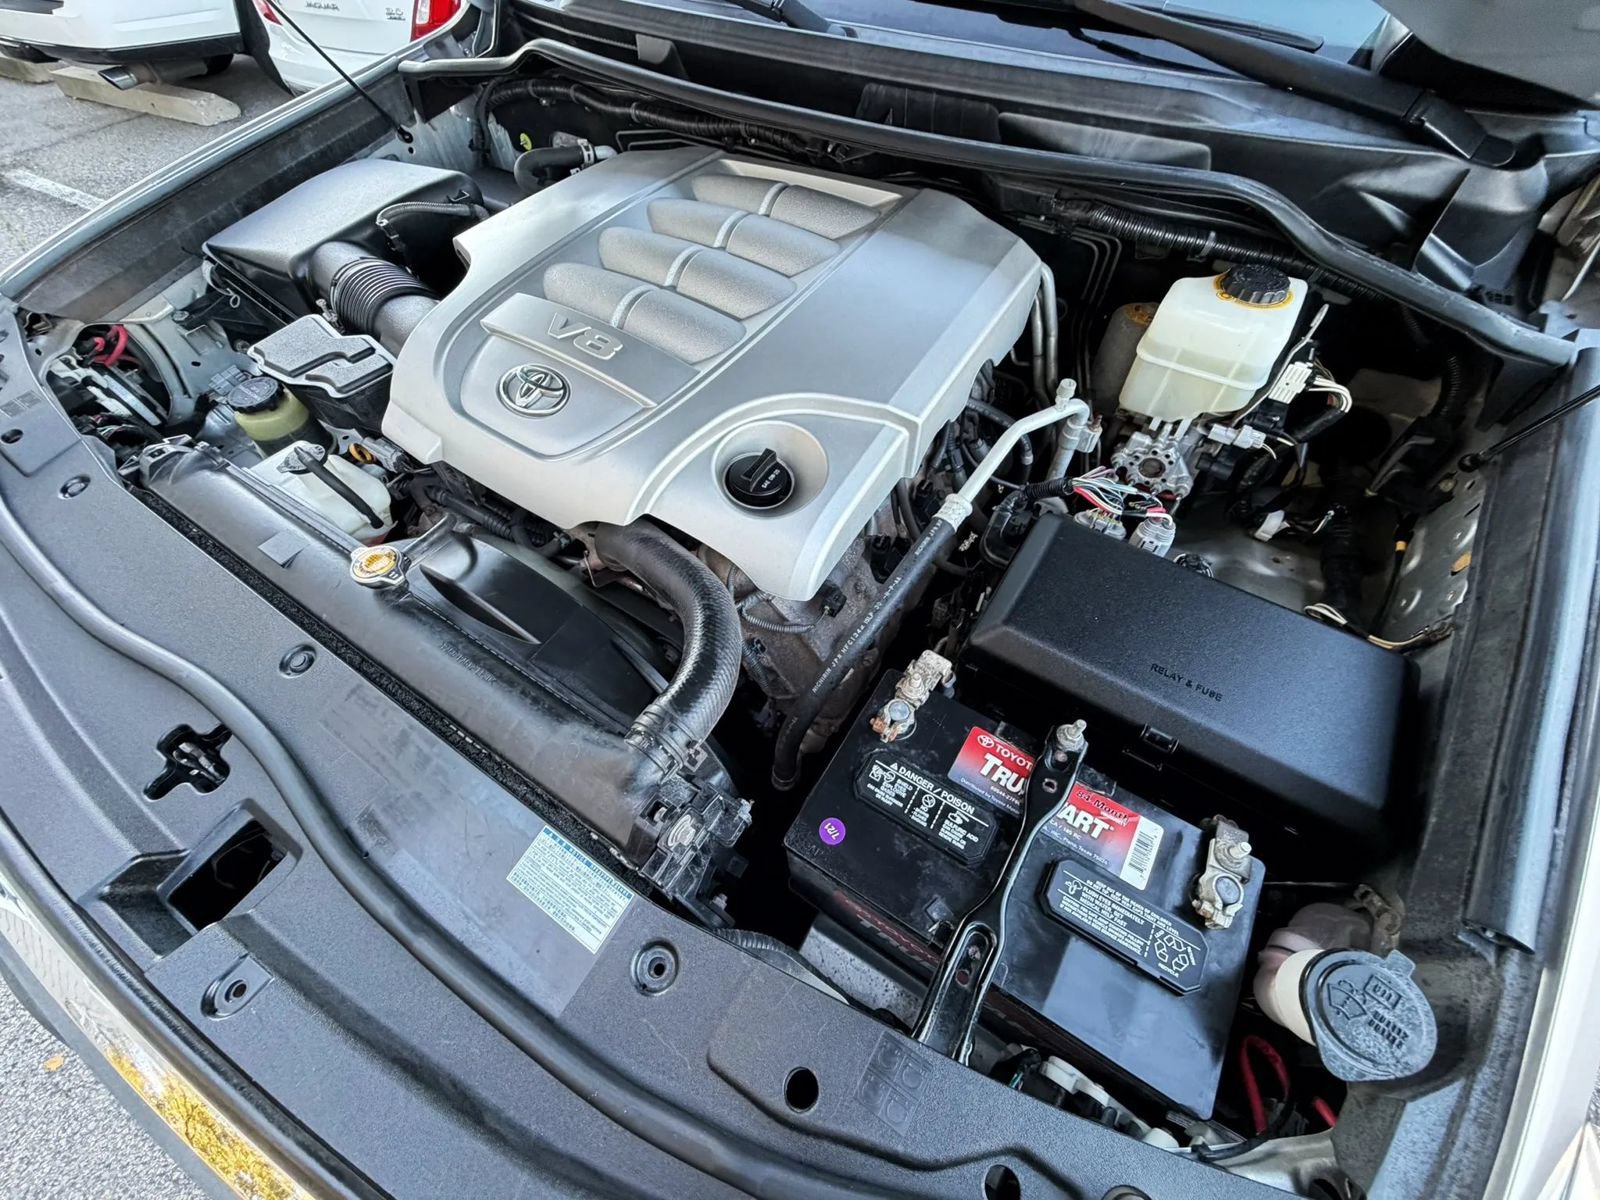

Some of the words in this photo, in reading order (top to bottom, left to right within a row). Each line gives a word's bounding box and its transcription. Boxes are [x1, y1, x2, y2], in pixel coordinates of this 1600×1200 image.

[547, 311, 623, 361] V8
[1150, 663, 1184, 683] RELAY
[1185, 680, 1193, 688] &
[980, 753, 1024, 796] TRU
[996, 744, 1033, 769] TOYOT
[897, 766, 935, 791] DANGER
[940, 790, 975, 814] POISON
[1057, 803, 1110, 839] ART
